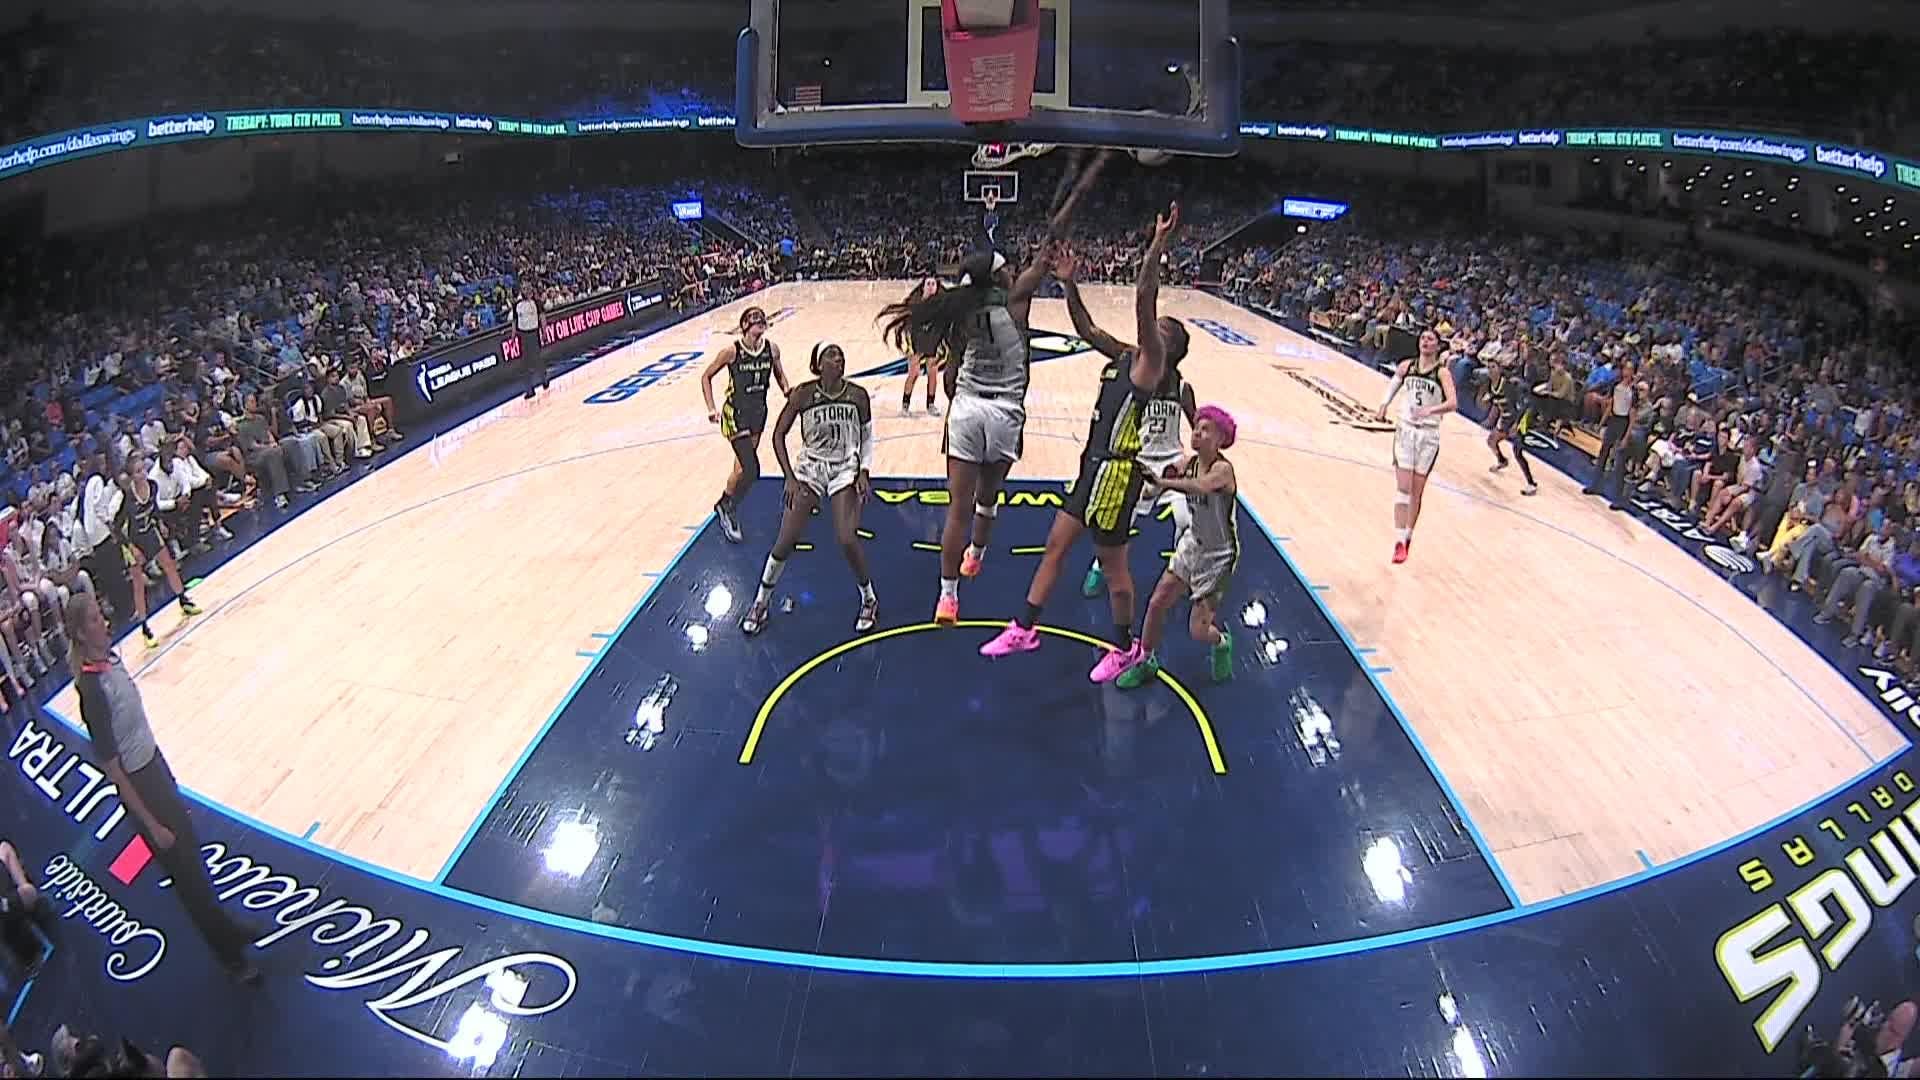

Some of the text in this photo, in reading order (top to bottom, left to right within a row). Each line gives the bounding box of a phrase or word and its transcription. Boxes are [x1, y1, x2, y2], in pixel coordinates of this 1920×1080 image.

[147, 115, 215, 137] betterhelp
[1815, 145, 1885, 177] betterhelp
[555, 319, 570, 339] ON
[569, 313, 587, 335] LIVE
[585, 308, 601, 328] CUP
[600, 301, 625, 322] GAMES
[1406, 378, 1435, 396] STORM
[1415, 391, 1423, 406] 5
[813, 405, 855, 424] STORM
[1148, 416, 1167, 433] 23
[828, 422, 841, 441] 11
[8, 720, 128, 841] ULTRA
[1737, 770, 1916, 894] DALLAS
[43, 853, 167, 982] Courtside
